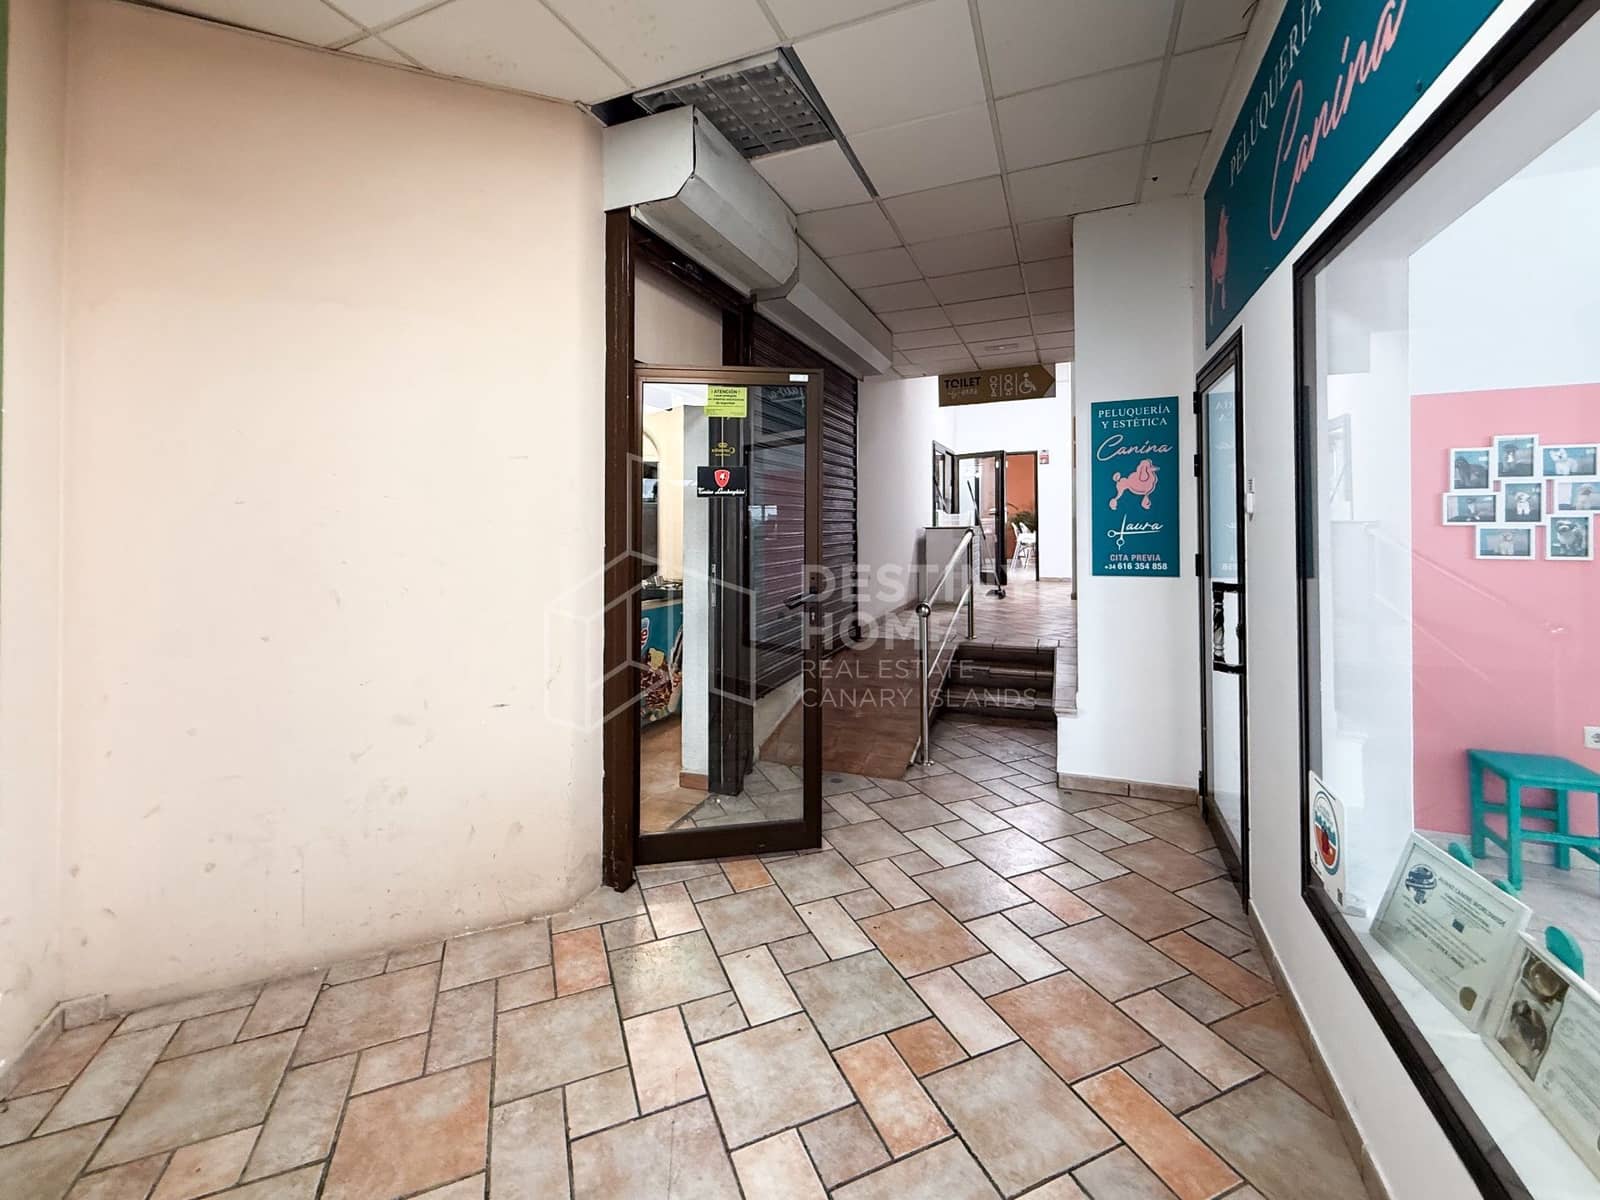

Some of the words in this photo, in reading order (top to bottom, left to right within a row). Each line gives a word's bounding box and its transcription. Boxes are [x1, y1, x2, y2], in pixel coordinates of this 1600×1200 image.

[1269, 0, 1407, 241] Canina
[944, 377, 982, 389] TOILET
[1098, 403, 1171, 418] PELUQUERÍA
[1101, 420, 1109, 429] Y
[1113, 416, 1168, 429] ESTÉTICA
[1096, 434, 1173, 461] Canina
[1110, 553, 1129, 562] CITA
[1131, 553, 1161, 562] PREVIA
[1117, 562, 1133, 570] 616
[1135, 562, 1150, 570] 354
[1152, 562, 1168, 570] 858
